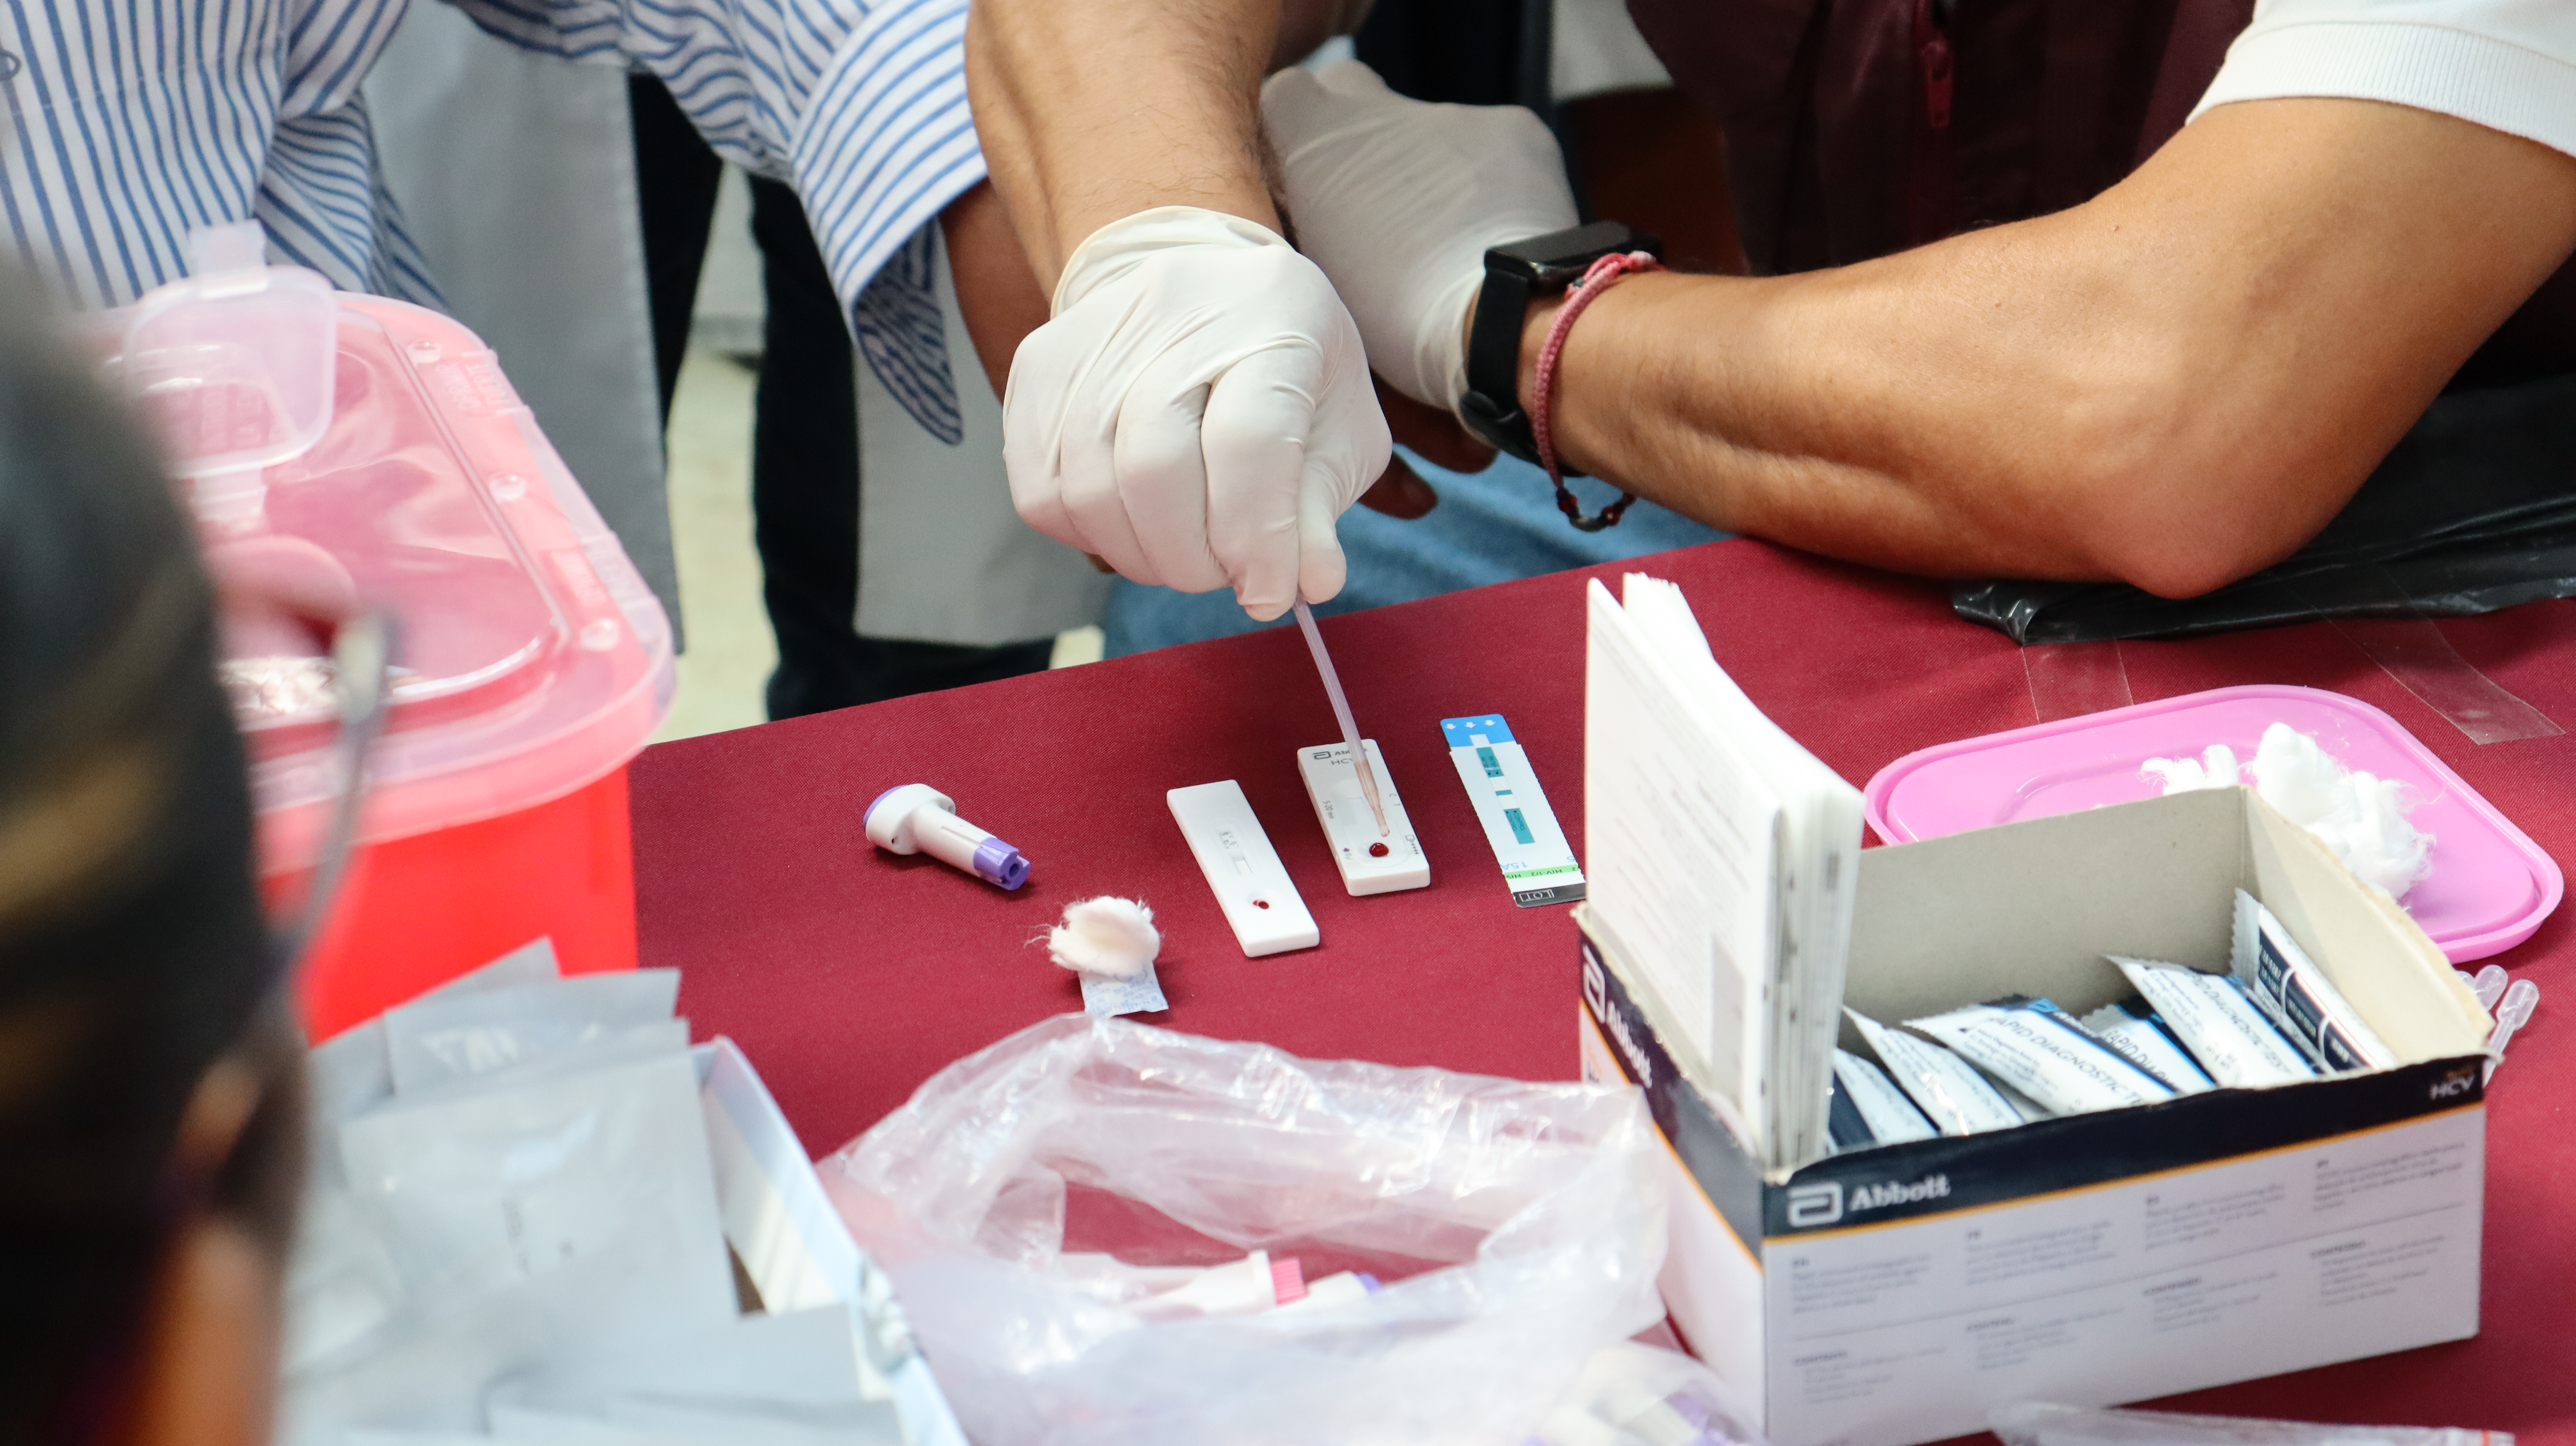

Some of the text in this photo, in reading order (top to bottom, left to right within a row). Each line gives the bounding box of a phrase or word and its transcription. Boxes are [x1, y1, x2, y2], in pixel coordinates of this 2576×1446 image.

[1500, 862, 1528, 870] 15A
[1526, 890, 1552, 900] LOT
[1606, 1000, 1653, 1089] Abbott
[2030, 1036, 2126, 1092] DIAGNOSTIC
[2430, 1074, 2476, 1100] HCV
[1849, 1173, 1951, 1212] Abbott
